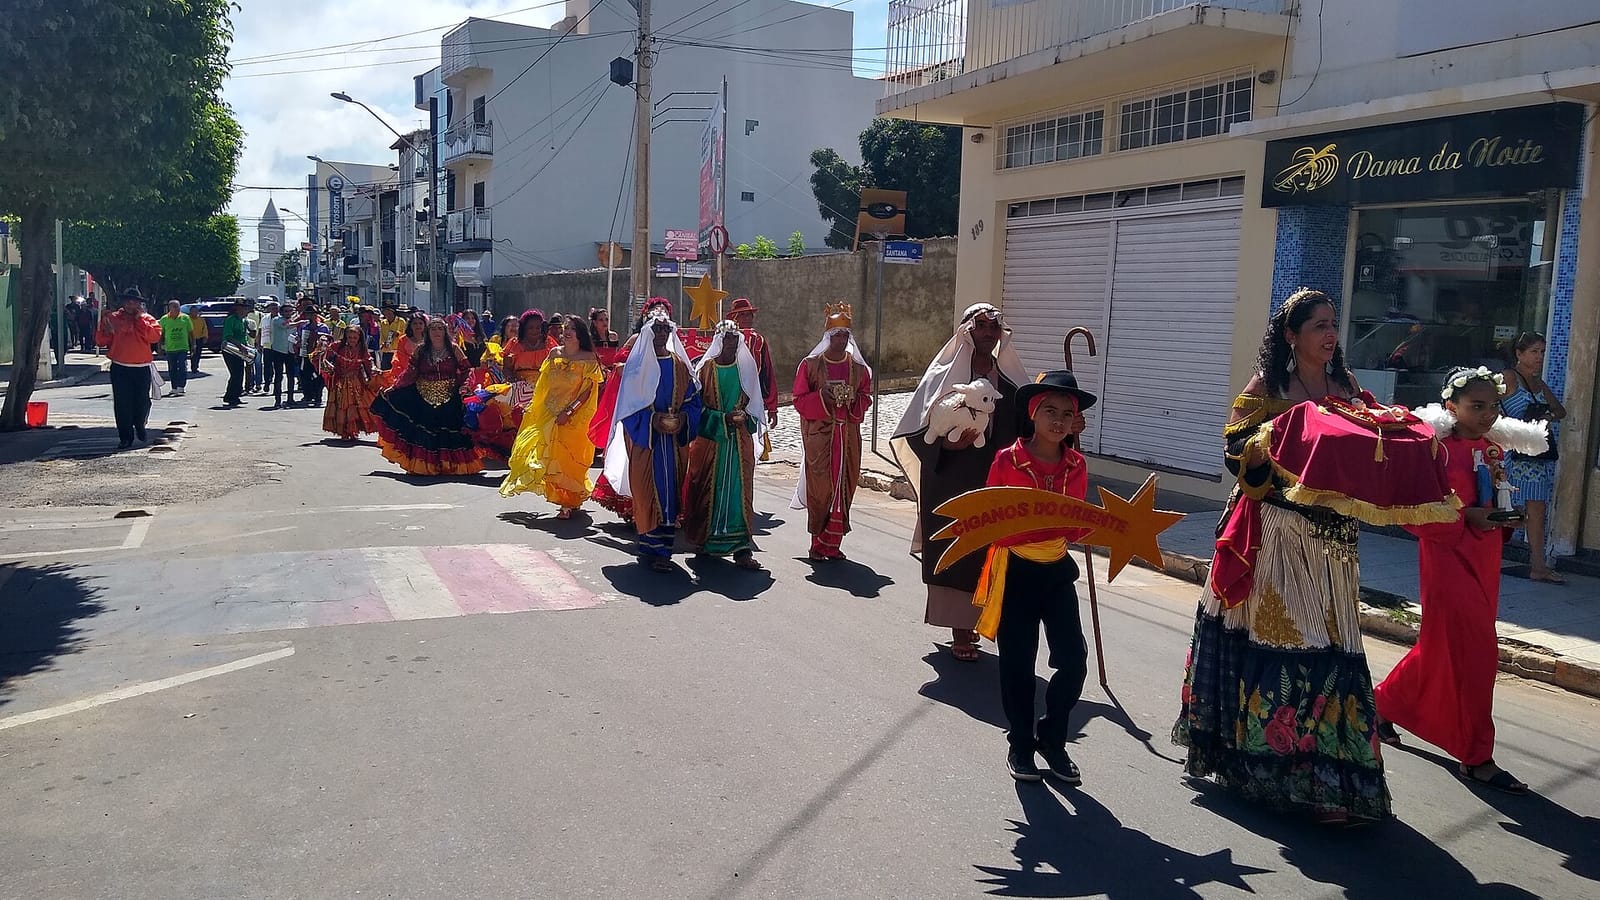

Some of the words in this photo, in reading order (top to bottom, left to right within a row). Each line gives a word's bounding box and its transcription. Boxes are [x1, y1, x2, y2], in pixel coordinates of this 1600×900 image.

[1346, 150, 1423, 180] Dama
[1428, 141, 1463, 171] da
[1467, 136, 1545, 167] Noite
[886, 249, 908, 257] SANTANA
[951, 502, 1030, 537] CIGANOS
[1033, 502, 1056, 516] DO
[1058, 502, 1130, 534] ORIENTE
